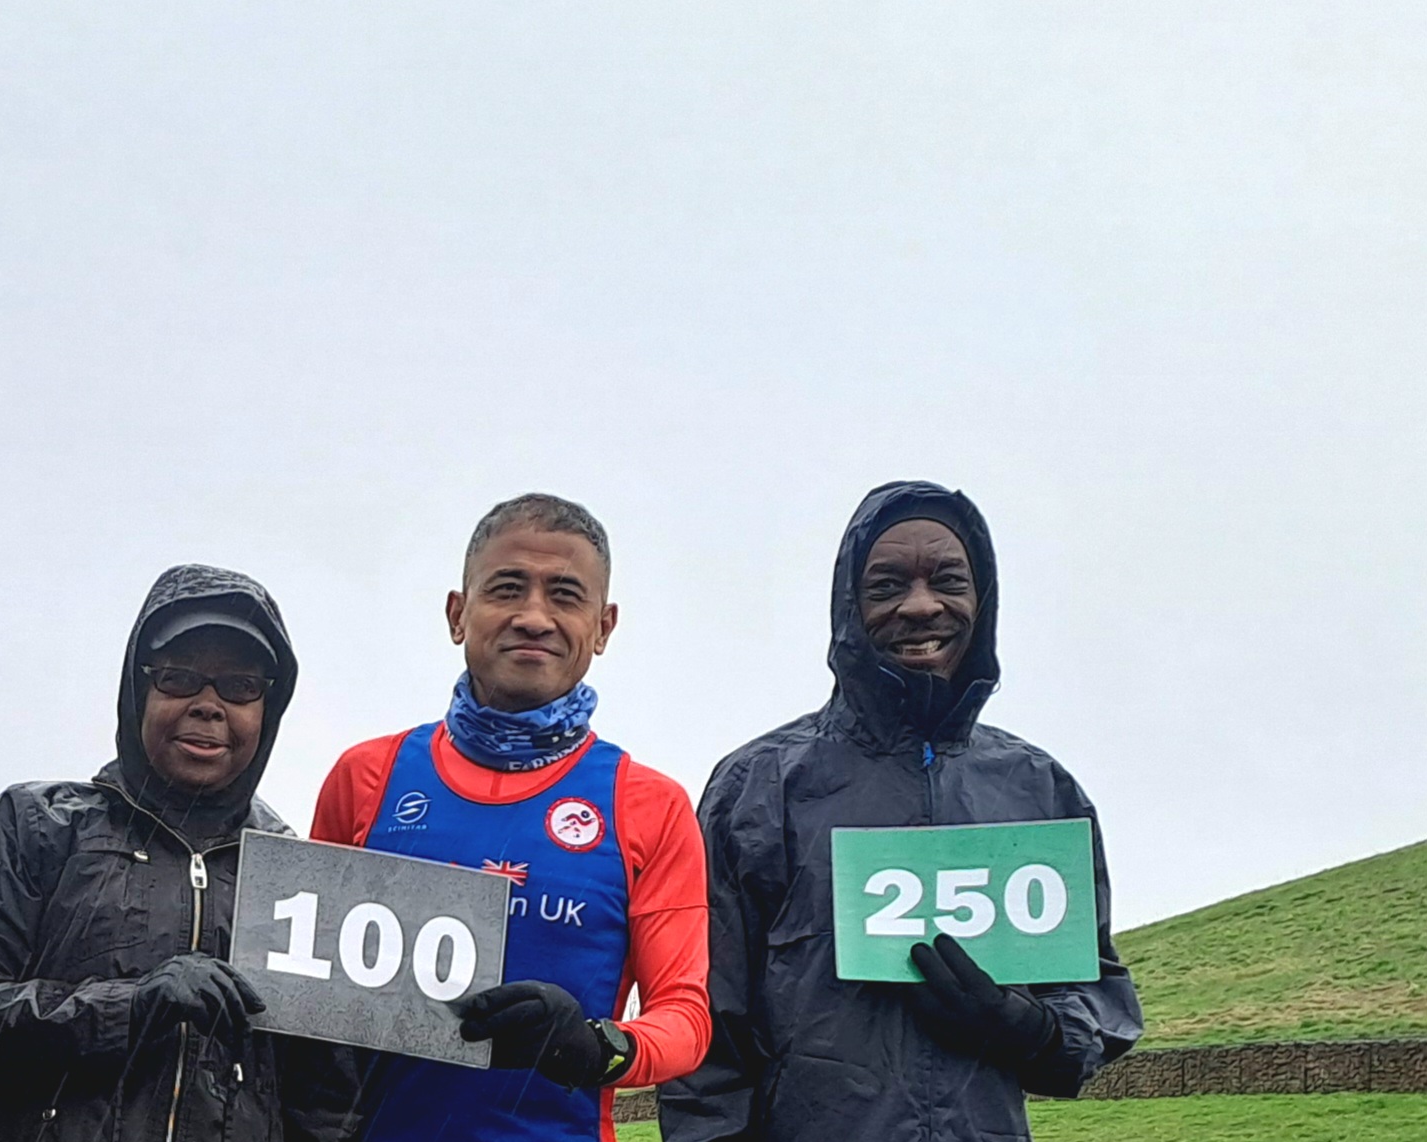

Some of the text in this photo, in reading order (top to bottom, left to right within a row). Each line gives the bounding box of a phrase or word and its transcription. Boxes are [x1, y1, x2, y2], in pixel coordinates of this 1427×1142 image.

[539, 894, 587, 926] UK
[863, 863, 1068, 938] 250
[266, 891, 477, 1001] 100
